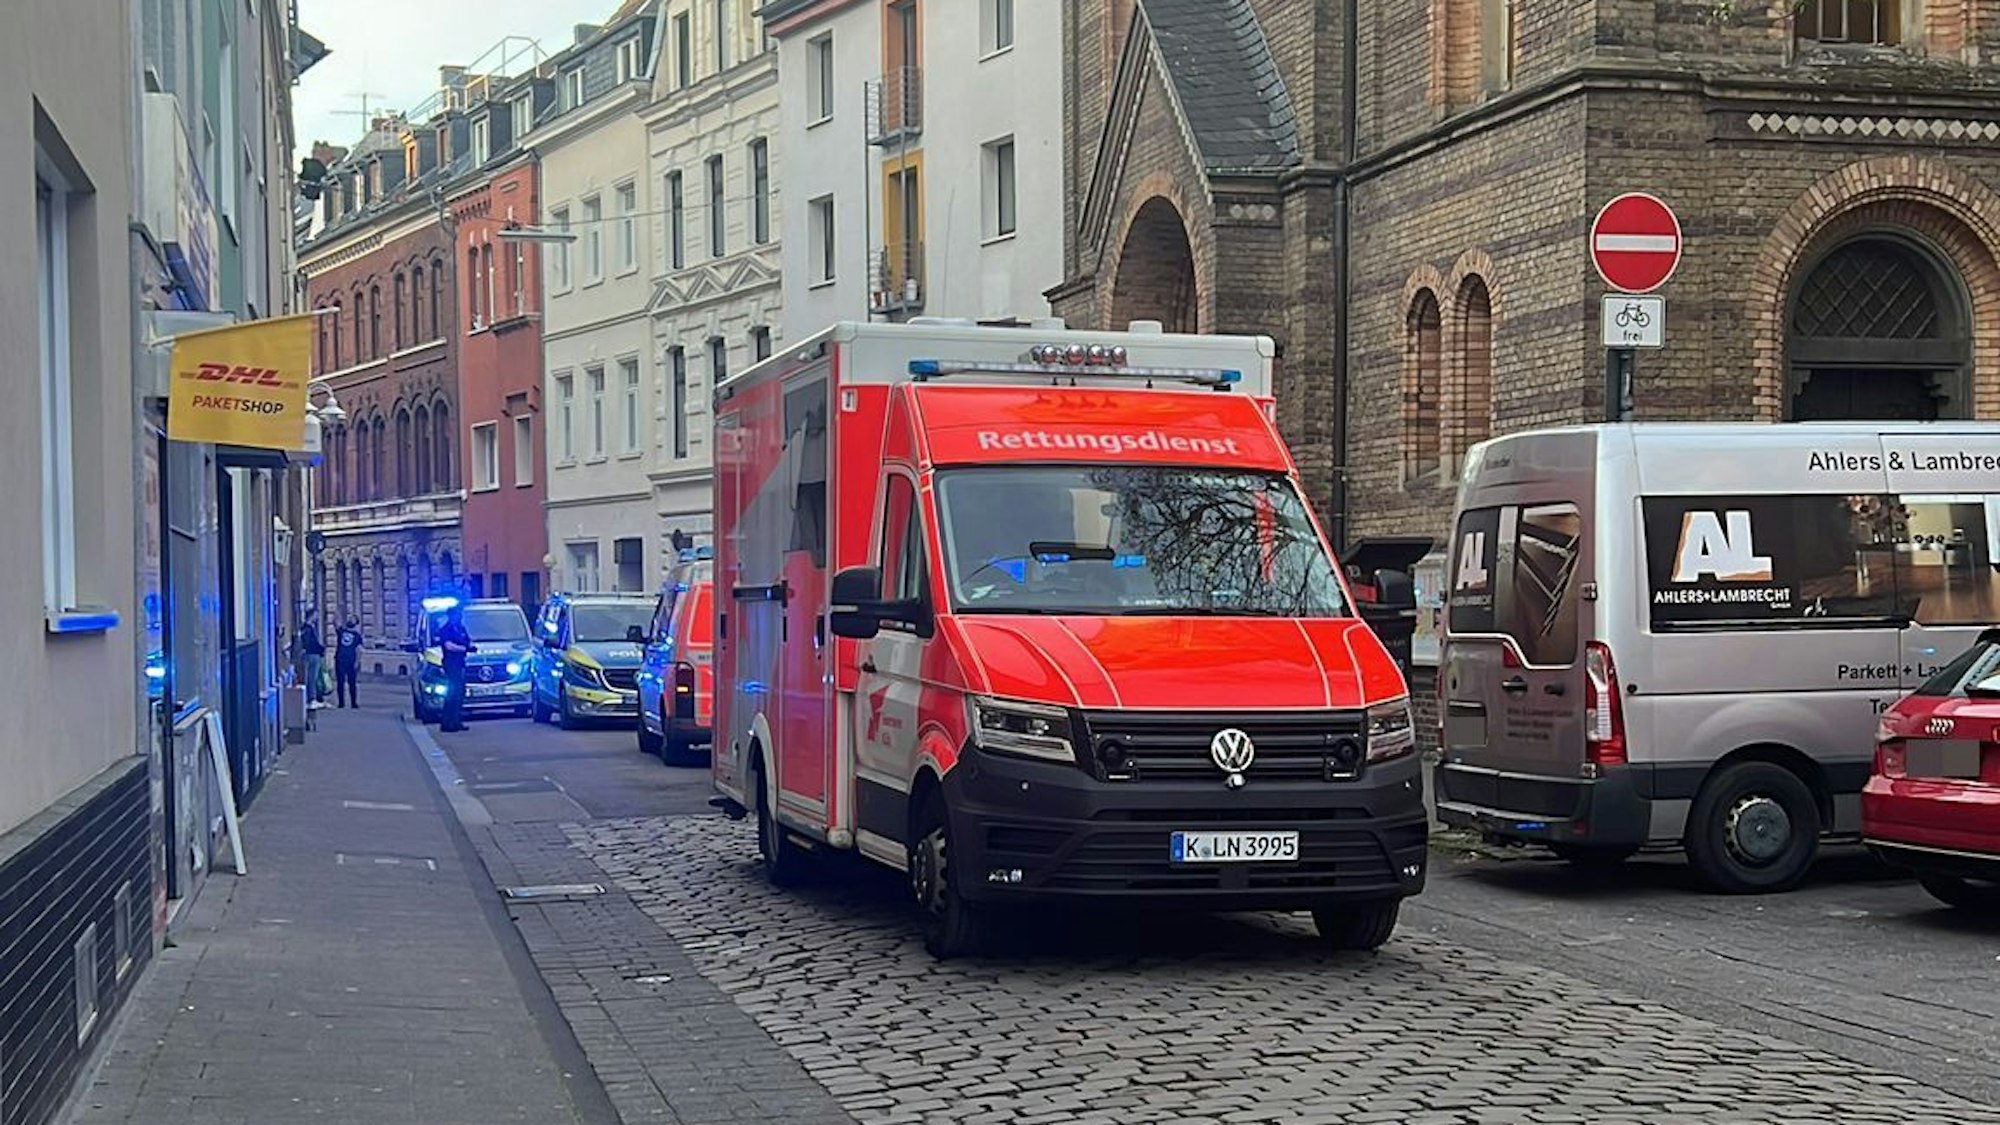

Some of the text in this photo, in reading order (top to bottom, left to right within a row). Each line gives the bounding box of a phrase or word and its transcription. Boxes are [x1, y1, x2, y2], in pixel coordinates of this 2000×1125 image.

[1623, 330, 1643, 341] frei
[197, 363, 283, 387] DHL
[192, 395, 284, 414] PAKETSHOP
[976, 431, 1240, 455] Rettungsdienst
[1808, 452, 1881, 471] Ahlers
[1888, 451, 1904, 471] &
[1671, 510, 1774, 583] AL
[1456, 531, 1488, 590] AL
[1653, 588, 1791, 604] AHLERS+LAMBRECHT
[1838, 664, 1897, 680] Parkett
[1186, 836, 1295, 858] K LN 3995
